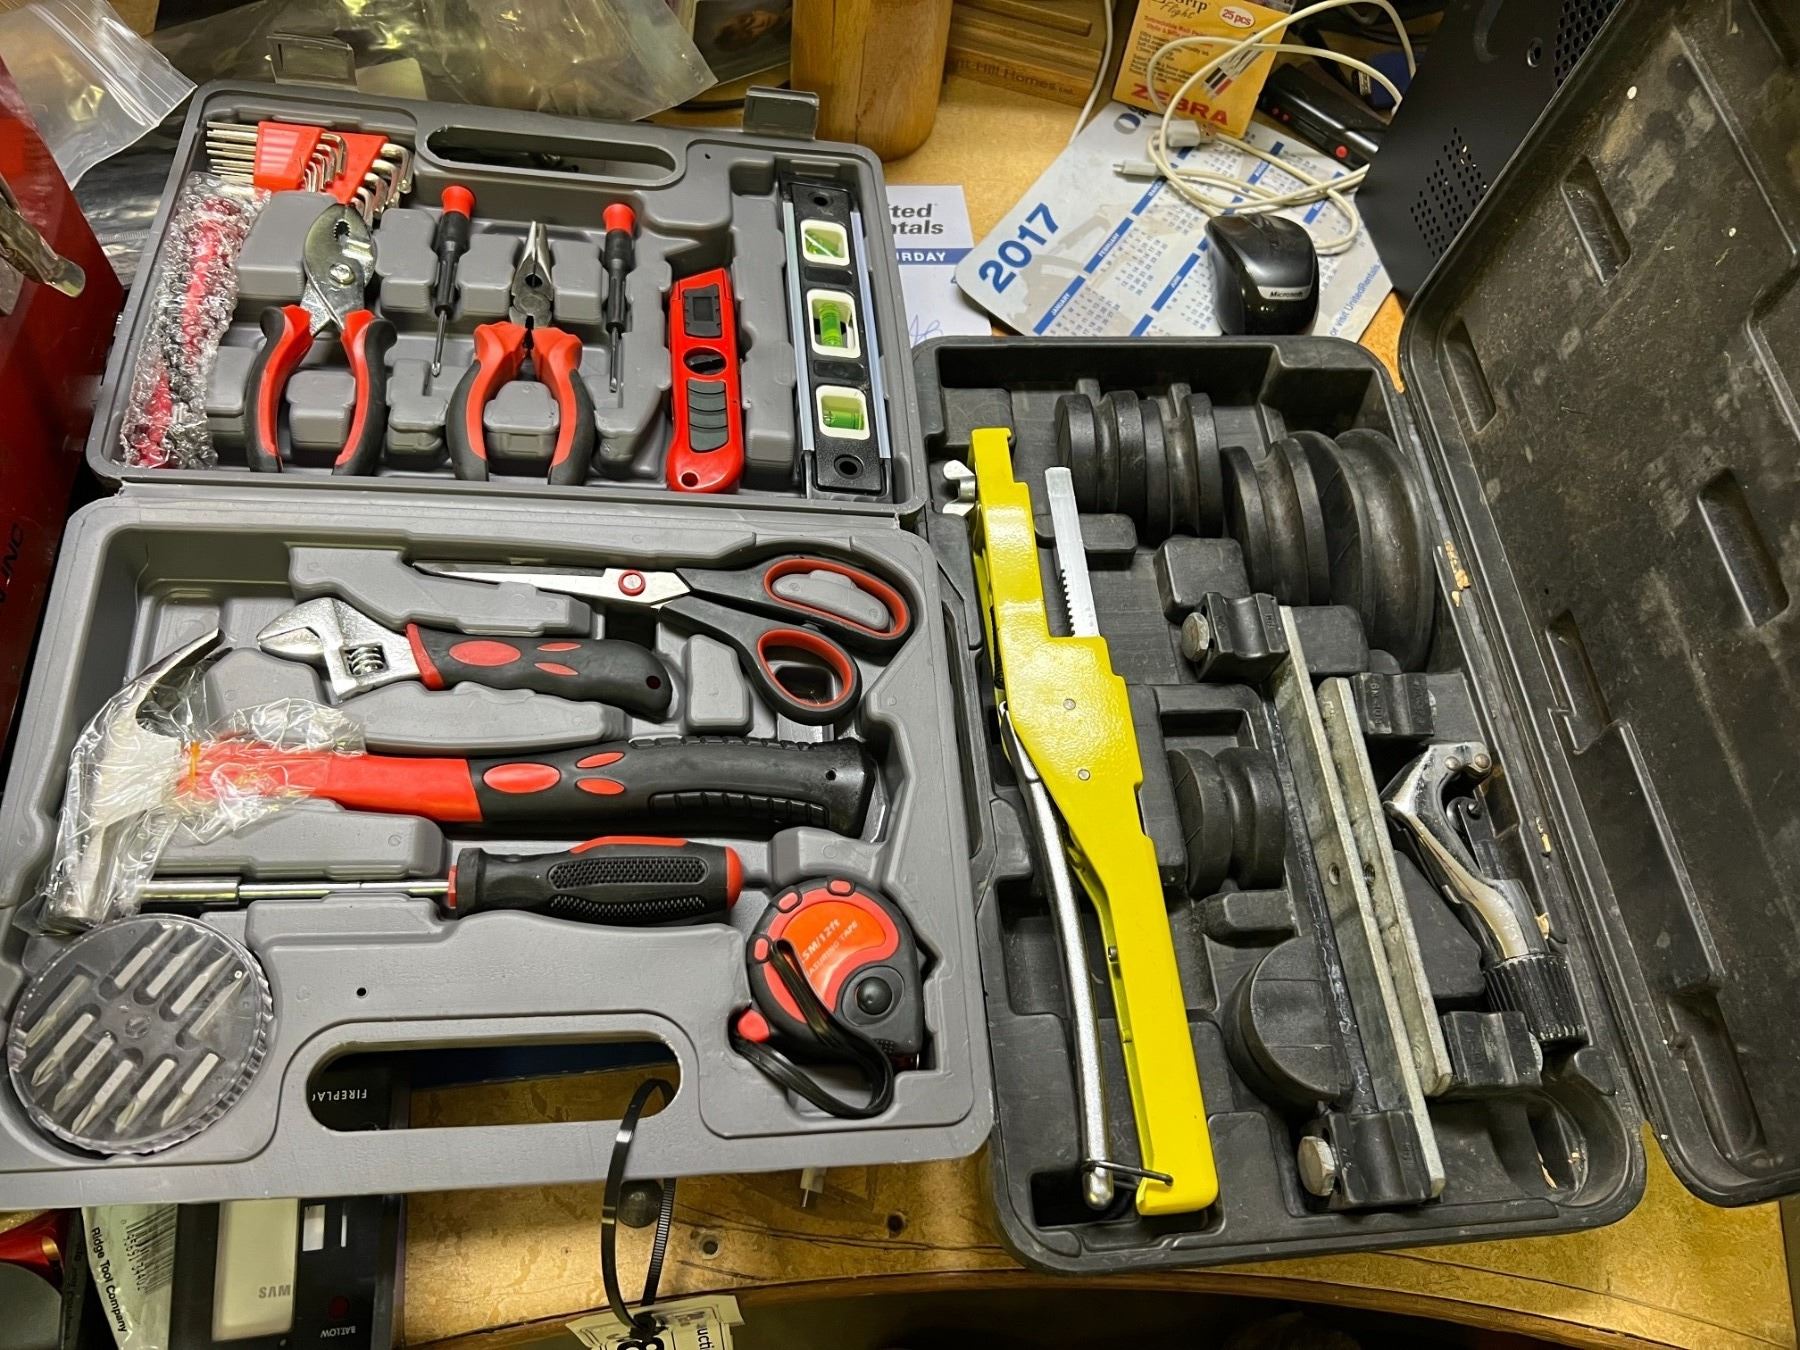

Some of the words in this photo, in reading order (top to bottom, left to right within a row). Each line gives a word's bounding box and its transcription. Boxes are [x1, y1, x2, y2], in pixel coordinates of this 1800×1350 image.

[1221, 9, 1234, 19] 25
[1234, 12, 1252, 26] pcs
[1003, 69, 1057, 91] Homes
[887, 203, 932, 218] ted
[896, 252, 946, 262] RDAY
[978, 202, 1059, 294] 2017
[1050, 292, 1070, 316] JANUARY
[91, 1226, 105, 1259] Ridge
[100, 1260, 114, 1283] Tool
[105, 1284, 128, 1333] Company
